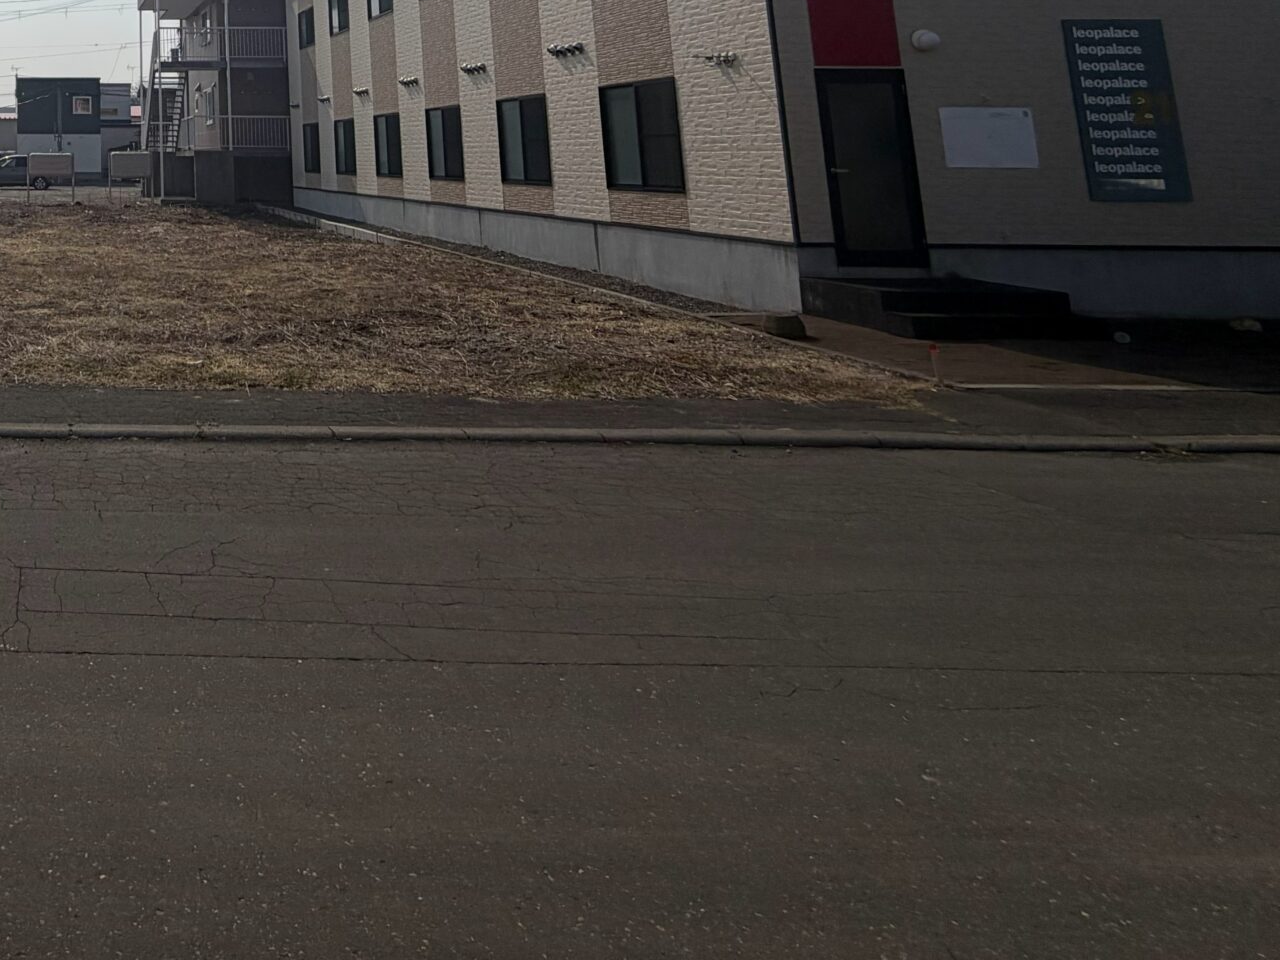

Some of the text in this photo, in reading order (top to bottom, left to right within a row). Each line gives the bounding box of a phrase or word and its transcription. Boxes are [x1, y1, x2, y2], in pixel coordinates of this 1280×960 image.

[1072, 26, 1140, 40] leopalace
[1075, 43, 1142, 56] leopalace
[1078, 59, 1145, 73] leopalace
[1080, 76, 1148, 89] leopalace
[1089, 127, 1157, 140] leopalace
[1091, 144, 1160, 157] leopalace
[1094, 161, 1162, 174] leopalace
